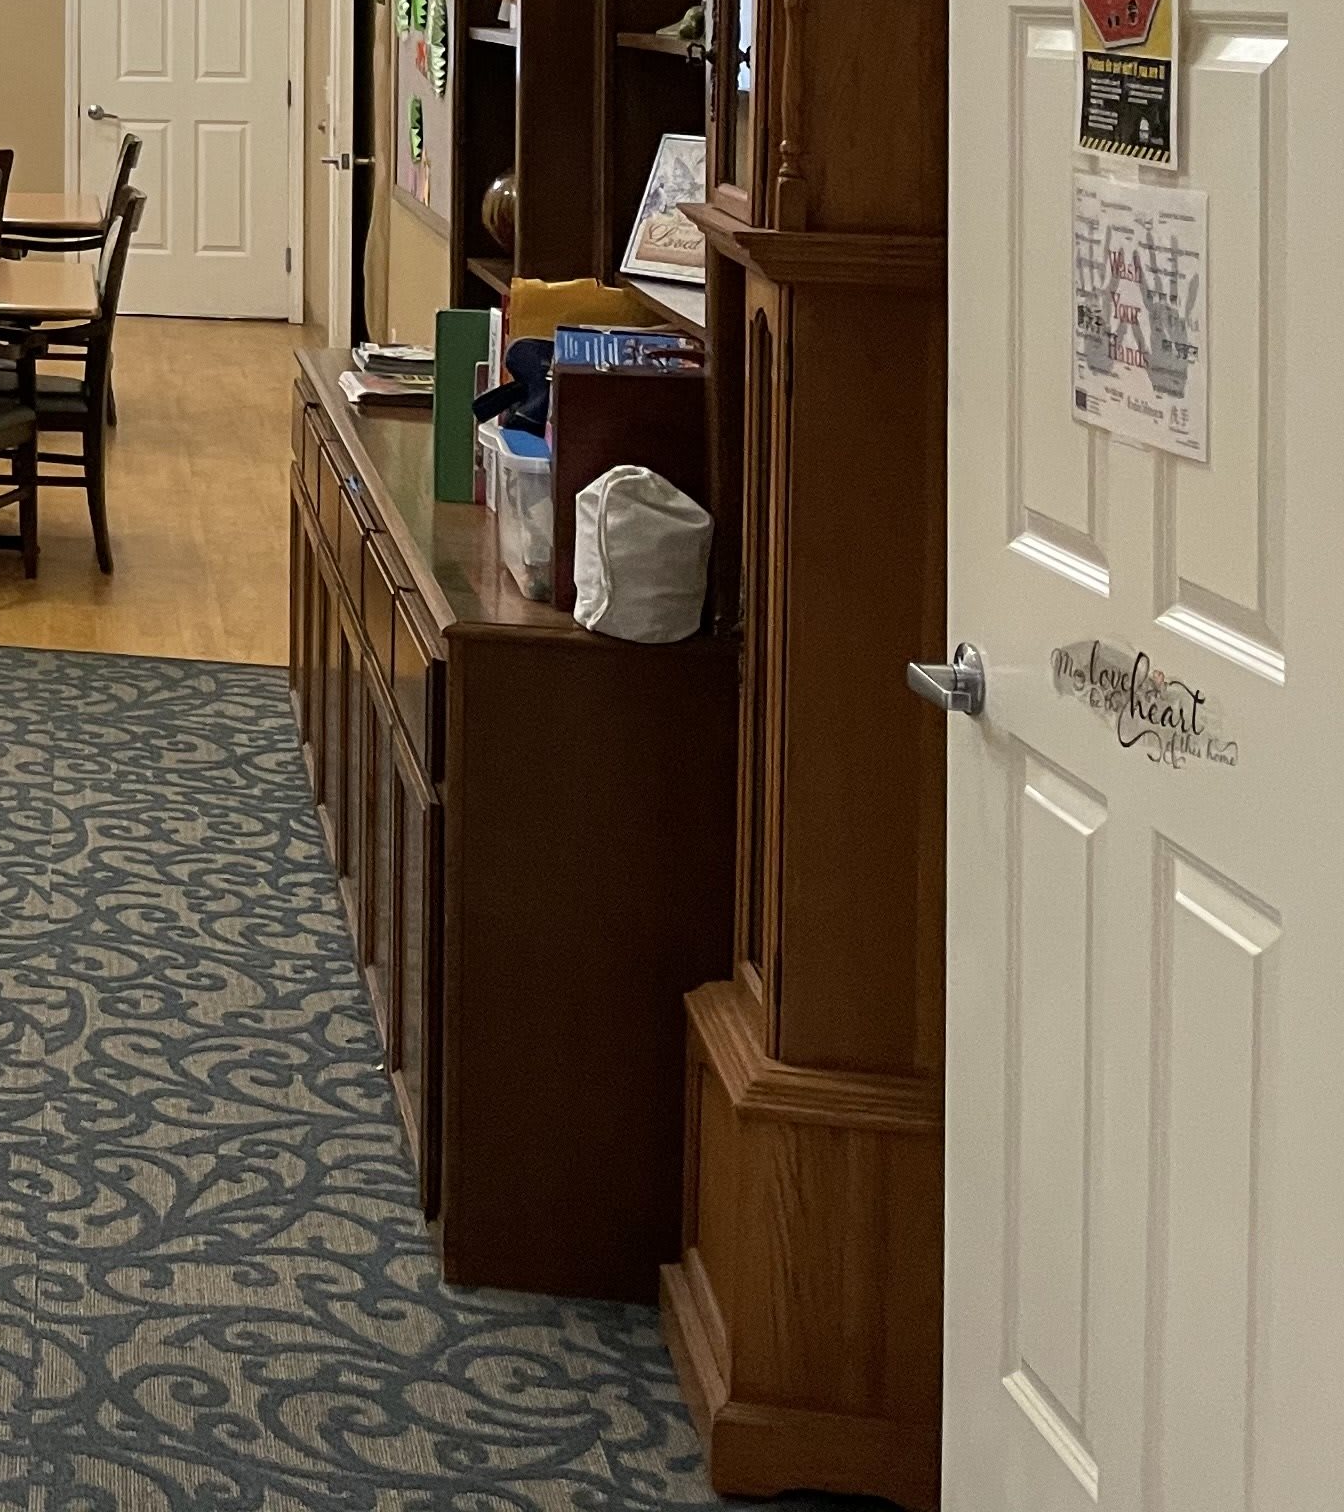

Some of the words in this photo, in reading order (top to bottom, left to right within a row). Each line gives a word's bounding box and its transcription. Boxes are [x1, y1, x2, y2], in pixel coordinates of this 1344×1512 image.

[1108, 250, 1142, 284] Wash
[1111, 291, 1142, 325] Your
[1107, 332, 1150, 369] Hands
[1126, 651, 1206, 740] heart
